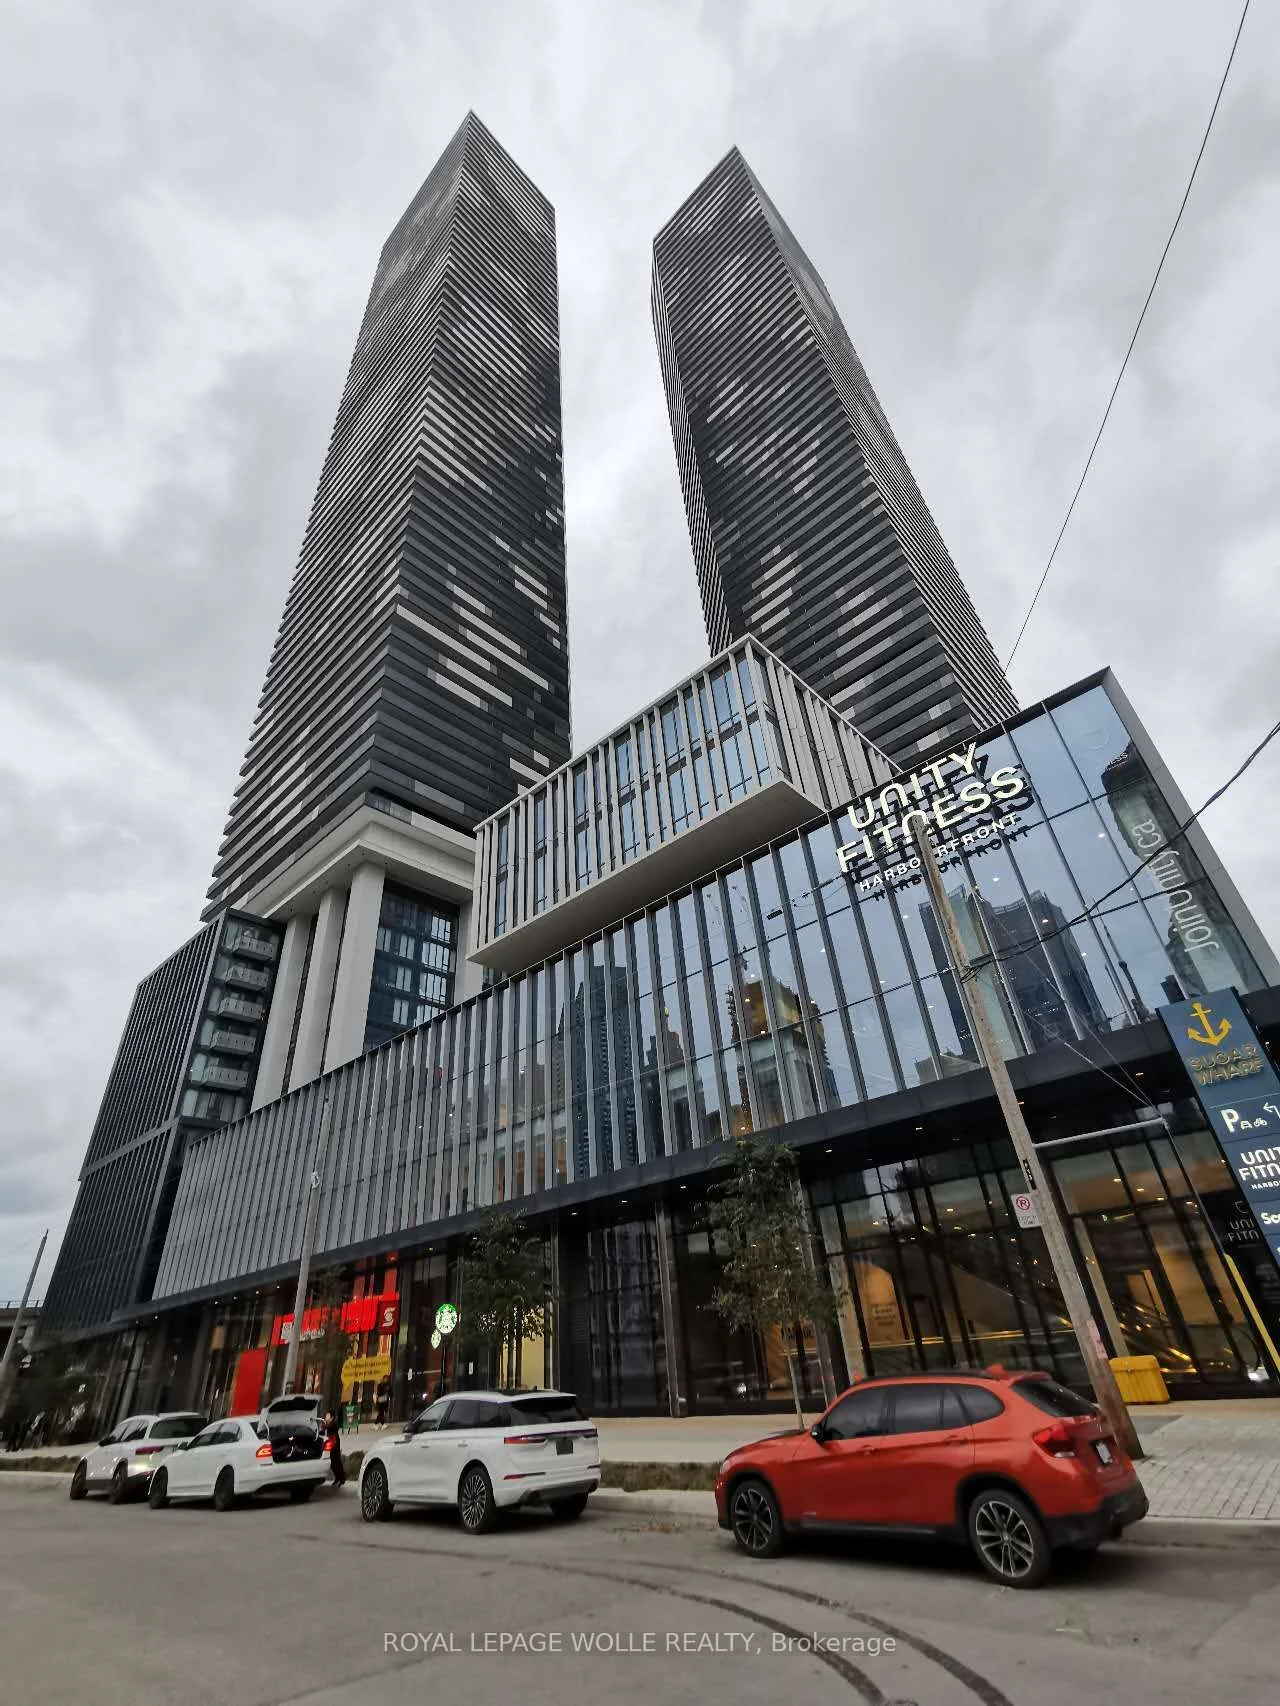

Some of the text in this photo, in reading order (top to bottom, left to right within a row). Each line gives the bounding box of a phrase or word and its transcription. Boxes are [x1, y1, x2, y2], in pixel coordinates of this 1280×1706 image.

[848, 742, 976, 829] UNITY
[836, 767, 1025, 873] FITNESS
[860, 812, 1019, 892] HARBORFRONT
[1190, 1044, 1257, 1071] SUGAR
[1200, 1058, 1264, 1086] WHARF
[1221, 1109, 1239, 1132] P
